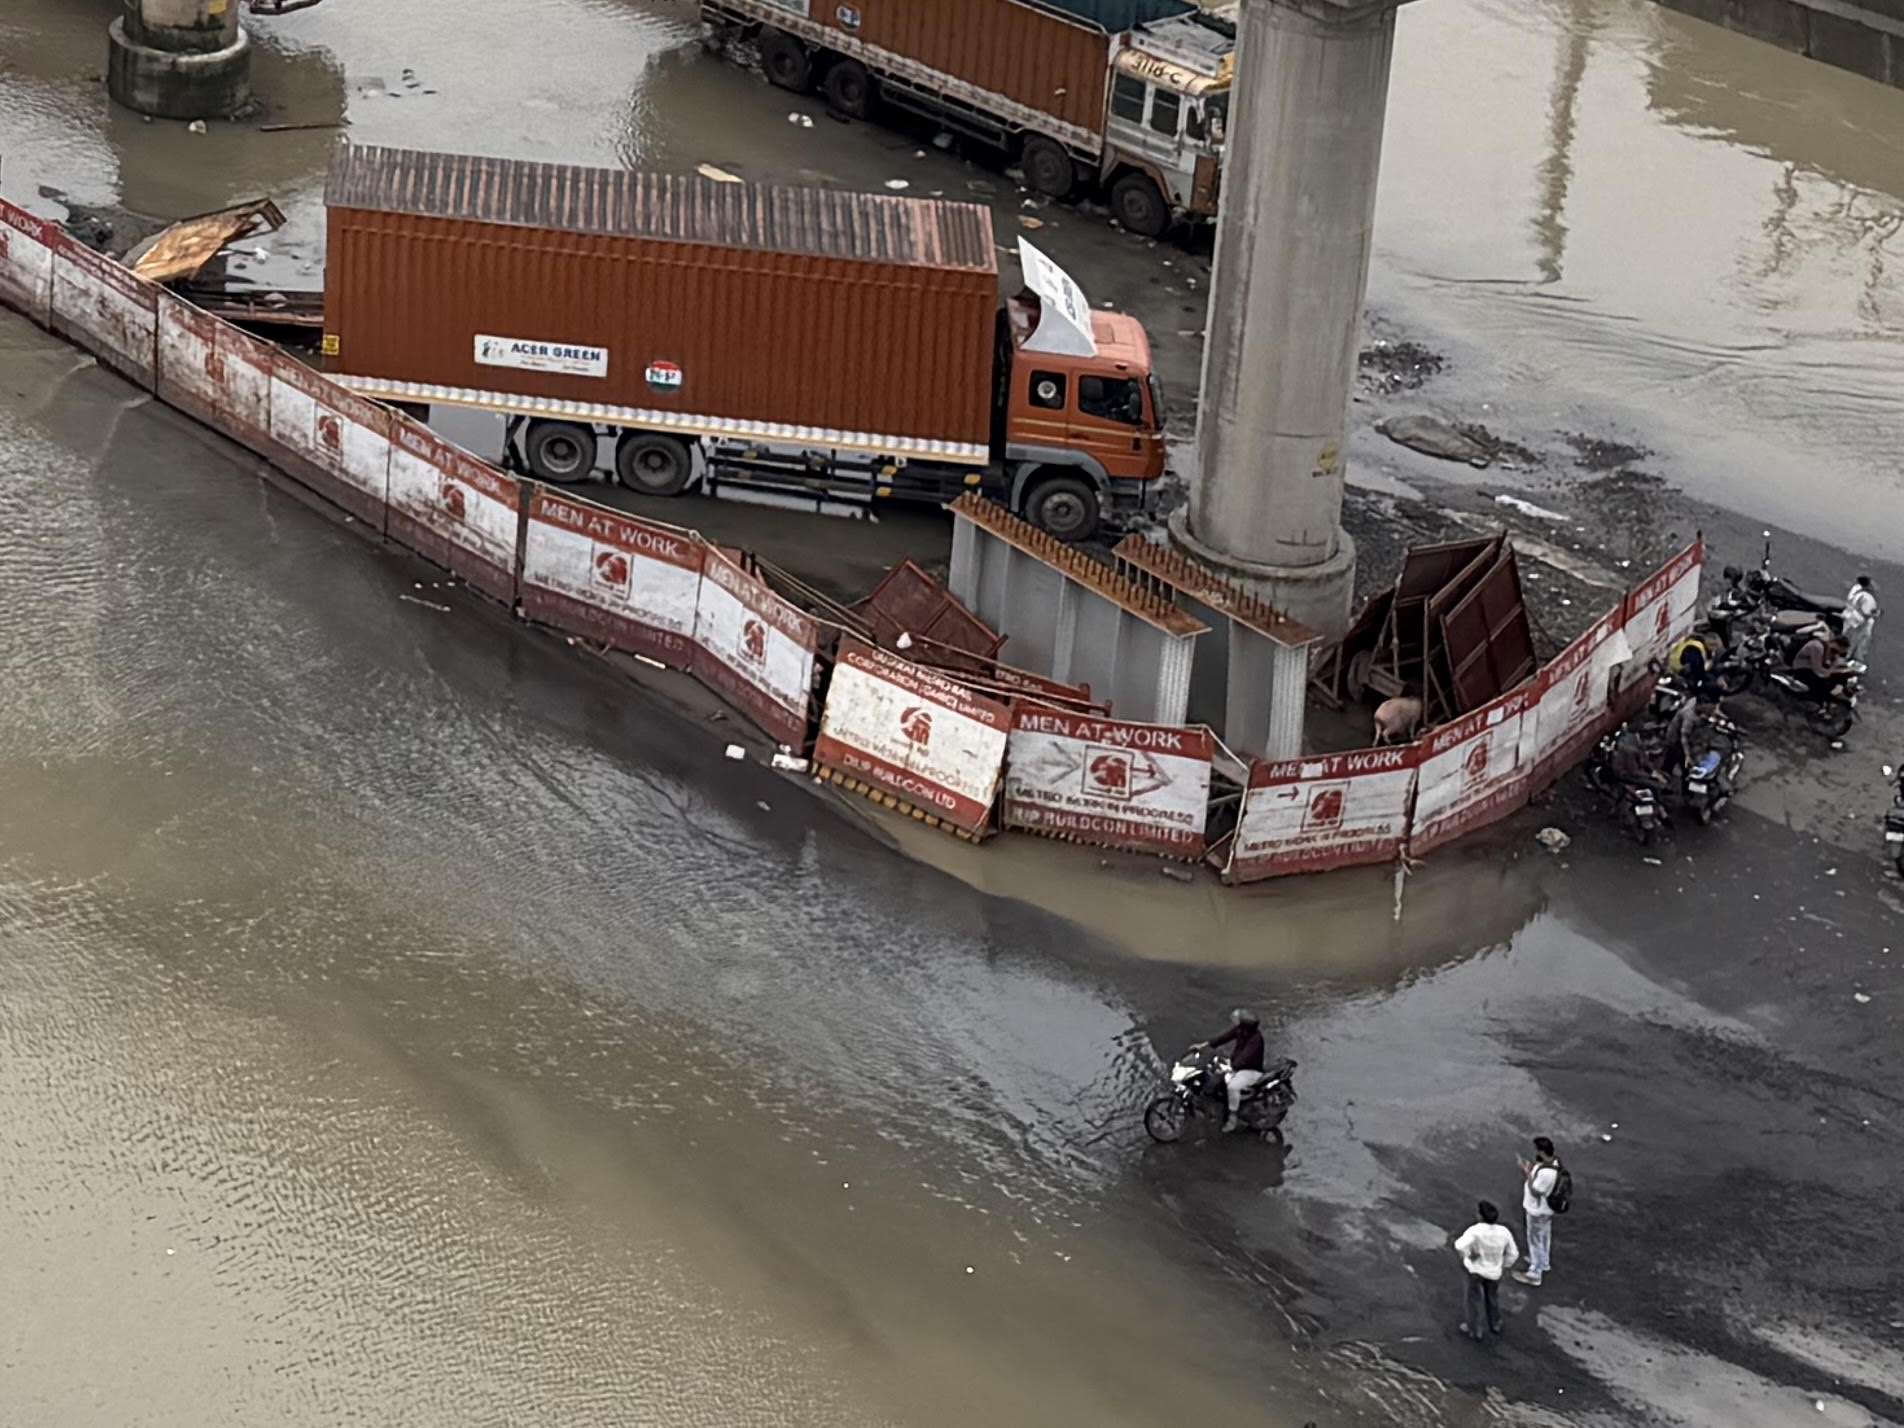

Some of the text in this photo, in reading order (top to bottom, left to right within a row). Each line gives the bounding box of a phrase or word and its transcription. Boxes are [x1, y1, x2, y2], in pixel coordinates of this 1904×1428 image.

[8, 213, 43, 240] WORK
[511, 342, 601, 362] ACER GREEN
[542, 499, 681, 557] MEN AT WORK
[1019, 714, 1183, 750] MEN AT WORK
[1347, 750, 1406, 771] WORK
[935, 790, 957, 810] LTD
